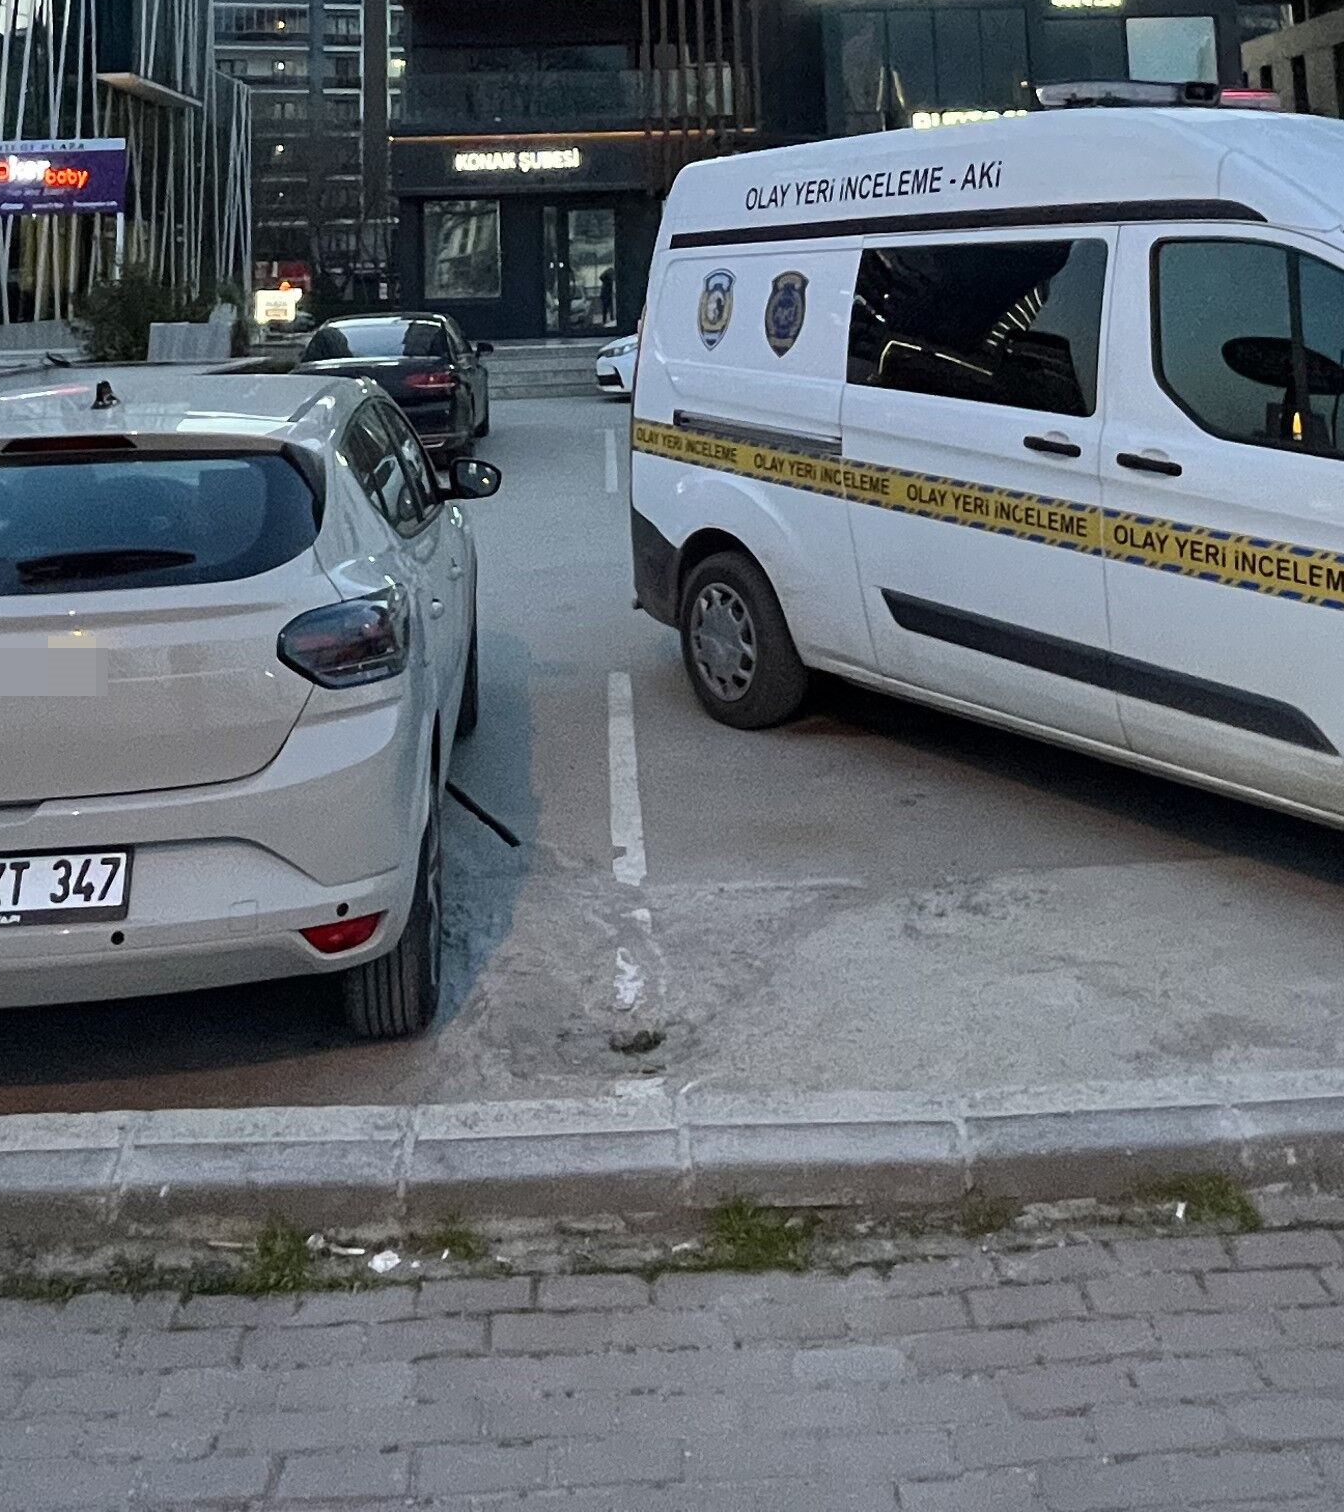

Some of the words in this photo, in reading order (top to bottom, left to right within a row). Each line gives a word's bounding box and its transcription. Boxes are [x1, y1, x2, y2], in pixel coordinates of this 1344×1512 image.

[455, 152, 517, 171] KONAK
[745, 187, 792, 211] OLAY
[636, 426, 661, 444] OLAY
[753, 452, 784, 473] OLAY
[906, 483, 948, 507] OLAY
[1113, 524, 1170, 554] OLAY
[49, 856, 122, 904] 347
